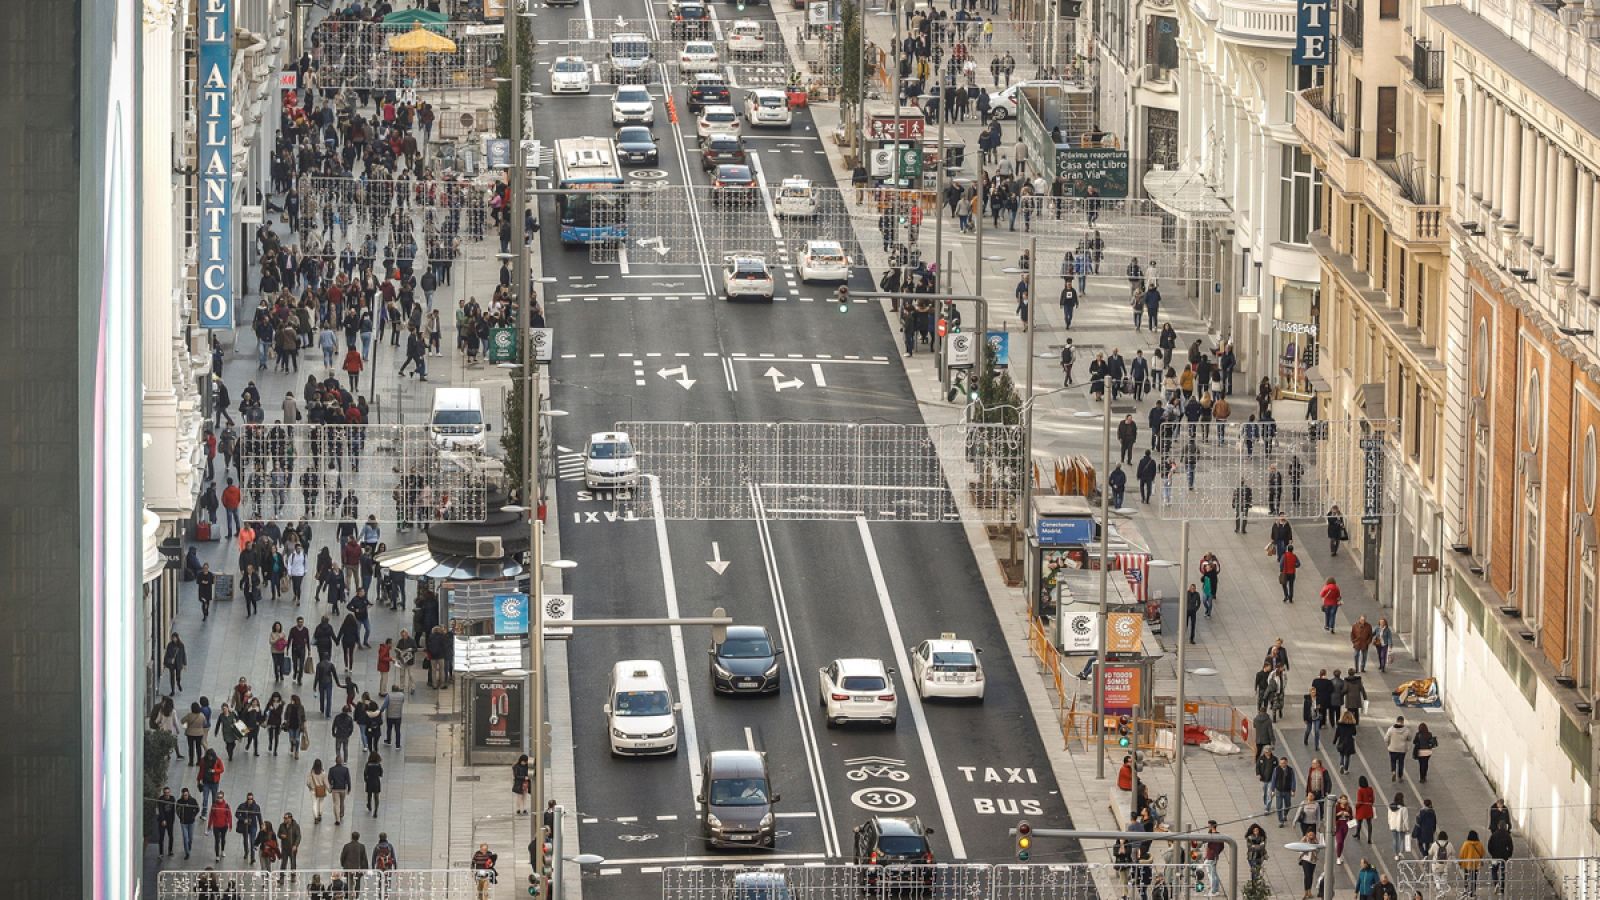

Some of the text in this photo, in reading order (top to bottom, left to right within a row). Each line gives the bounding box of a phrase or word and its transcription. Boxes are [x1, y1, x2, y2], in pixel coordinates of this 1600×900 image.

[1060, 151, 1127, 161] Próxima reapertura
[1060, 160, 1127, 169] Casa del Libro
[1060, 170, 1083, 180] Gran
[203, 62, 228, 321] ATLANTICO
[957, 766, 1038, 784] TAXI
[866, 793, 901, 805] 30
[973, 798, 1044, 816] BUS
